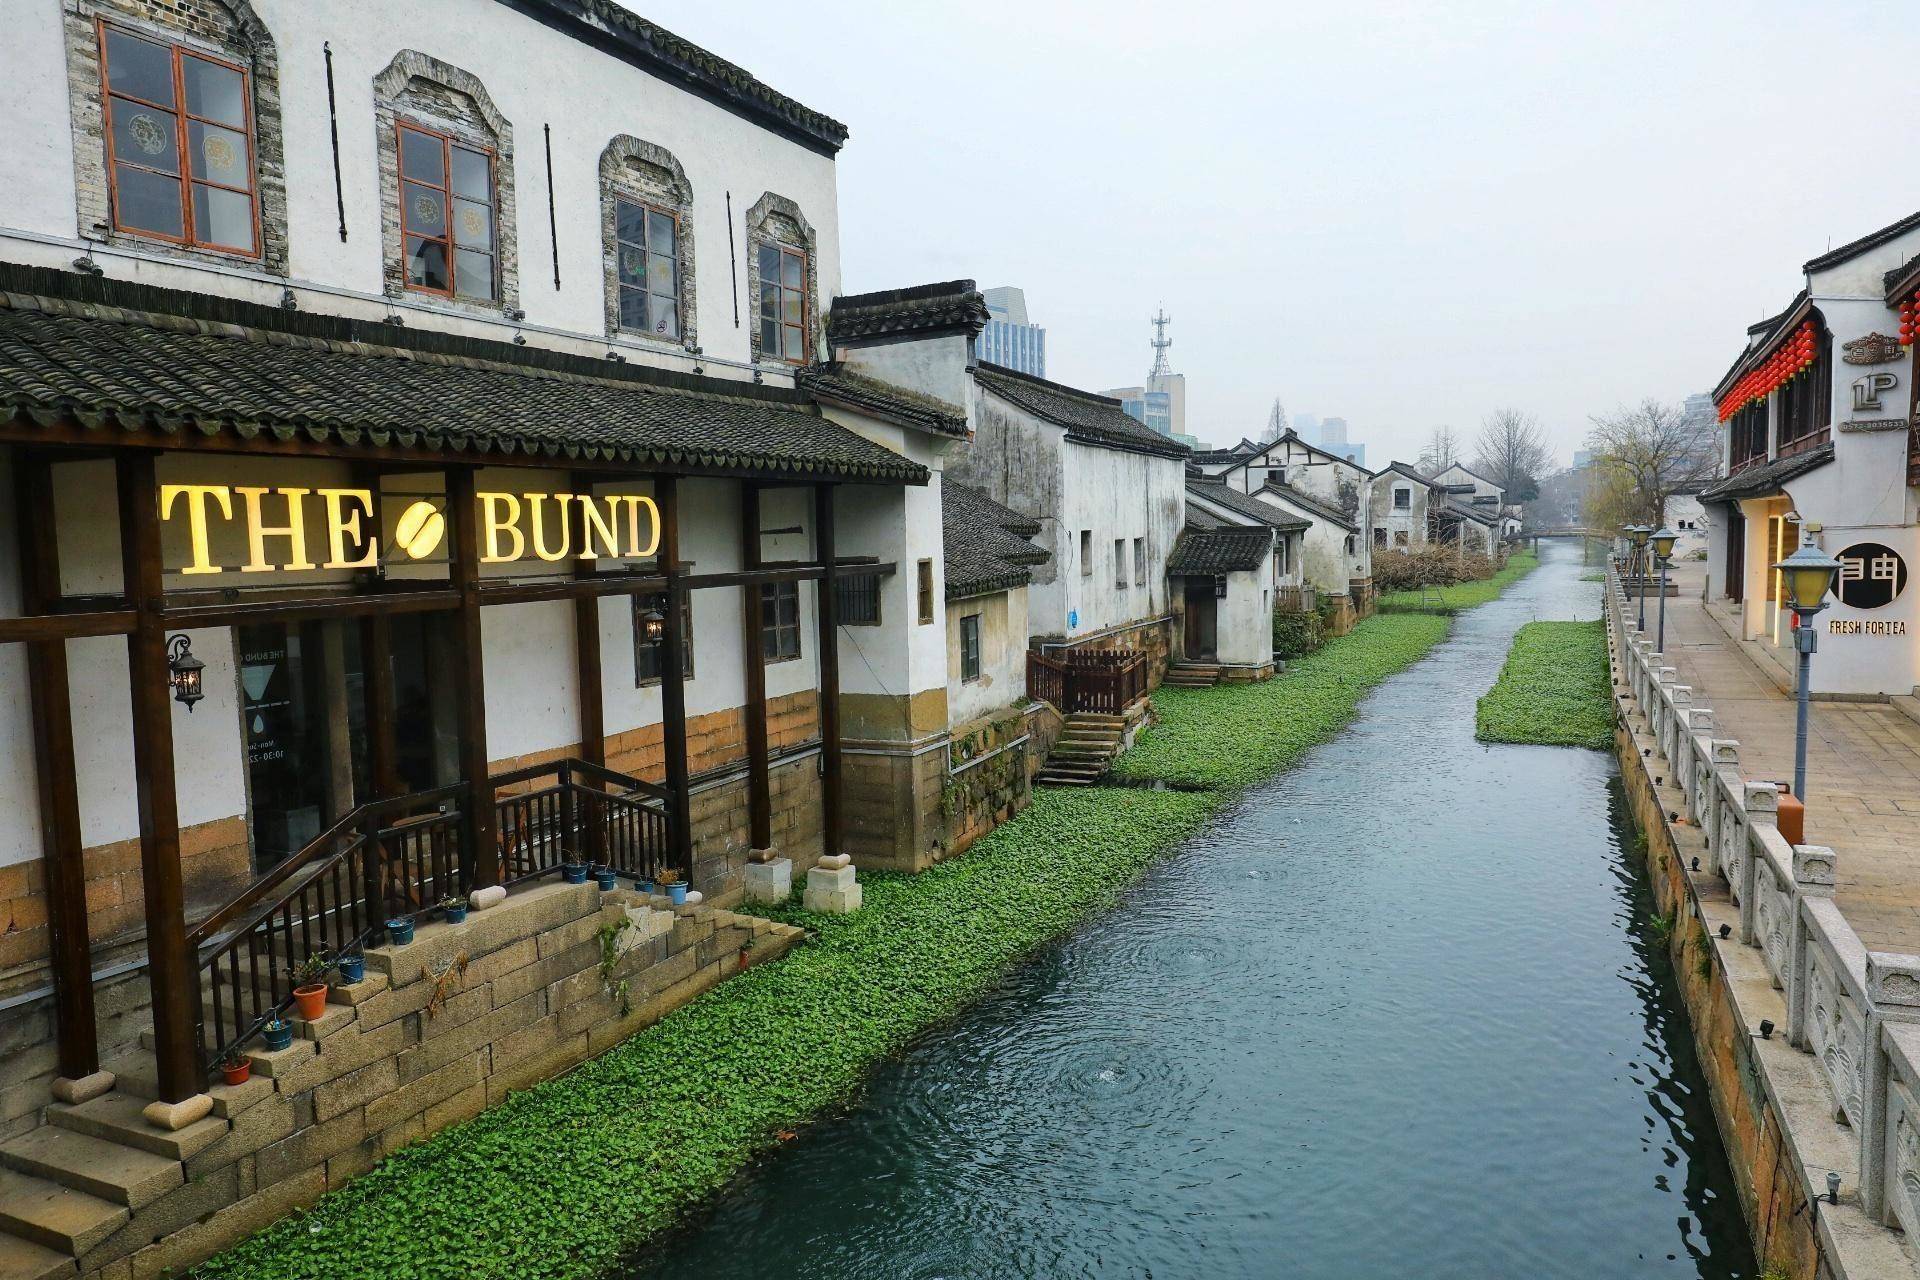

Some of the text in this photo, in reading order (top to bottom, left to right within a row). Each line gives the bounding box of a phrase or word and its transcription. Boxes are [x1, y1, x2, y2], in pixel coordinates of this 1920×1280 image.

[161, 484, 662, 575] THE BUND
[1830, 620, 1861, 634] FRESH
